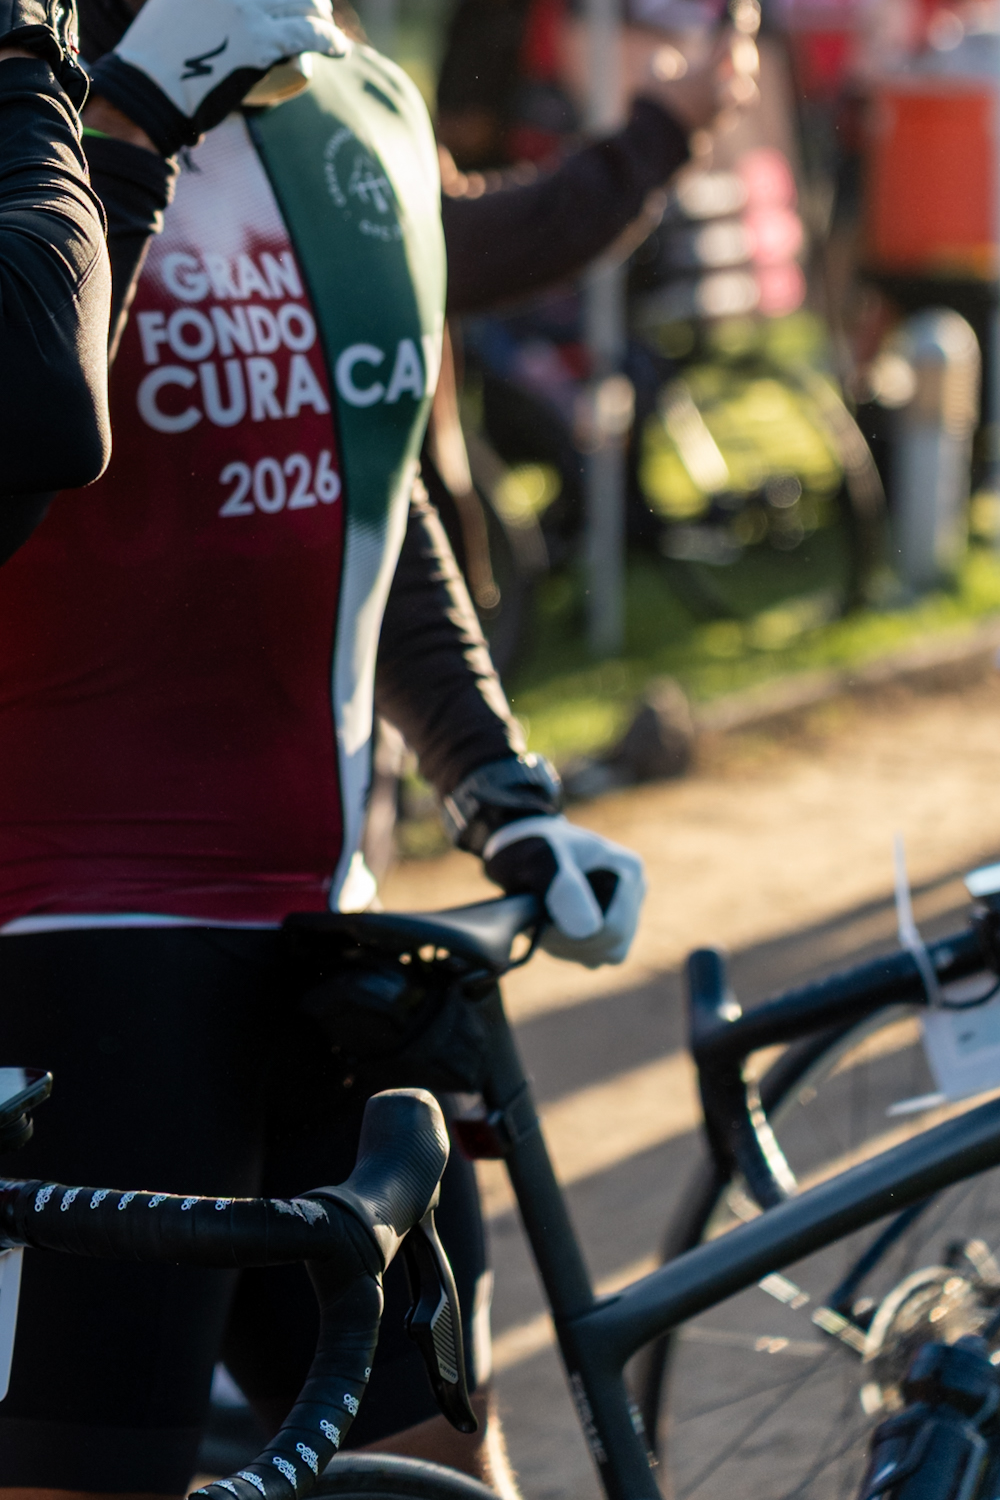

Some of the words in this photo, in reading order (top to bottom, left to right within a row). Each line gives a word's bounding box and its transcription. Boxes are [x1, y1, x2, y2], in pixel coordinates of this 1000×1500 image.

[161, 250, 304, 303] GRAN
[136, 303, 318, 365] FONDO
[218, 450, 342, 518] 2026
